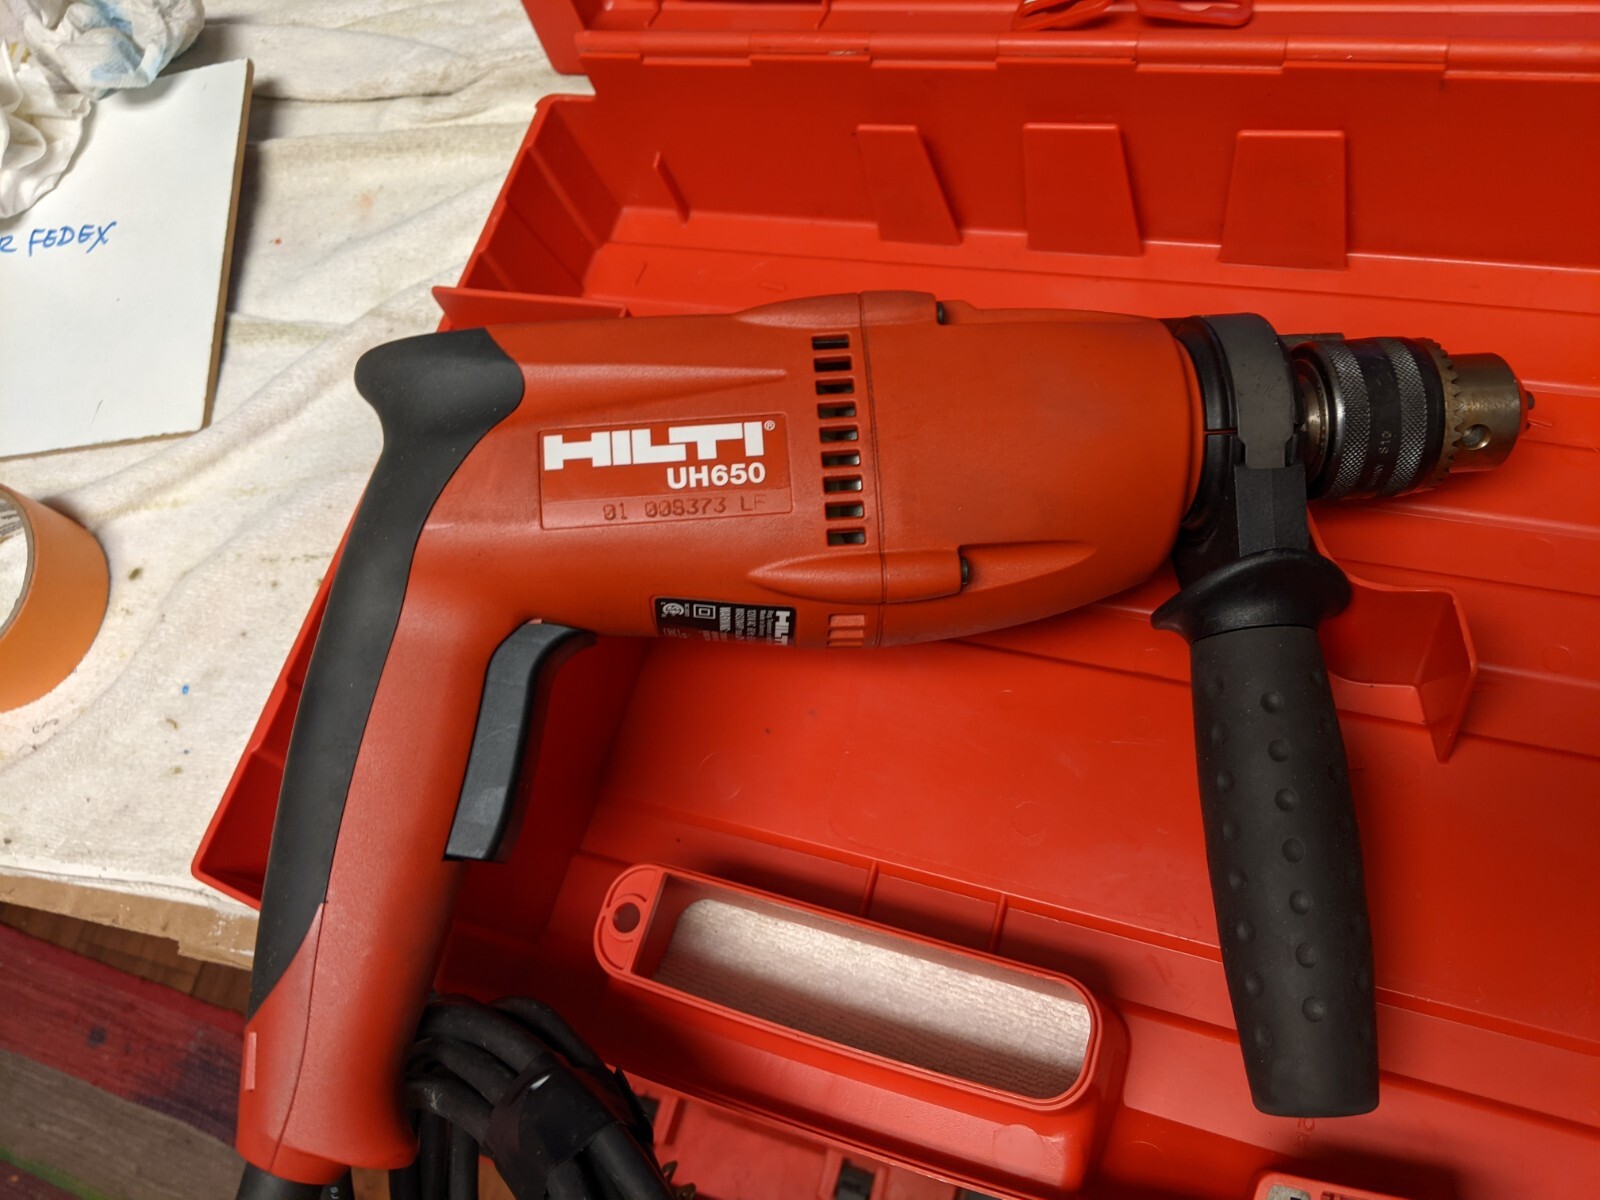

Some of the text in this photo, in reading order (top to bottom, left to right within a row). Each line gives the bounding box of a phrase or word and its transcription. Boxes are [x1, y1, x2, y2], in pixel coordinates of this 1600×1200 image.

[28, 220, 118, 257] FEDEX
[543, 421, 765, 471] HILTI
[666, 462, 766, 489] UH650
[602, 502, 628, 521] 01
